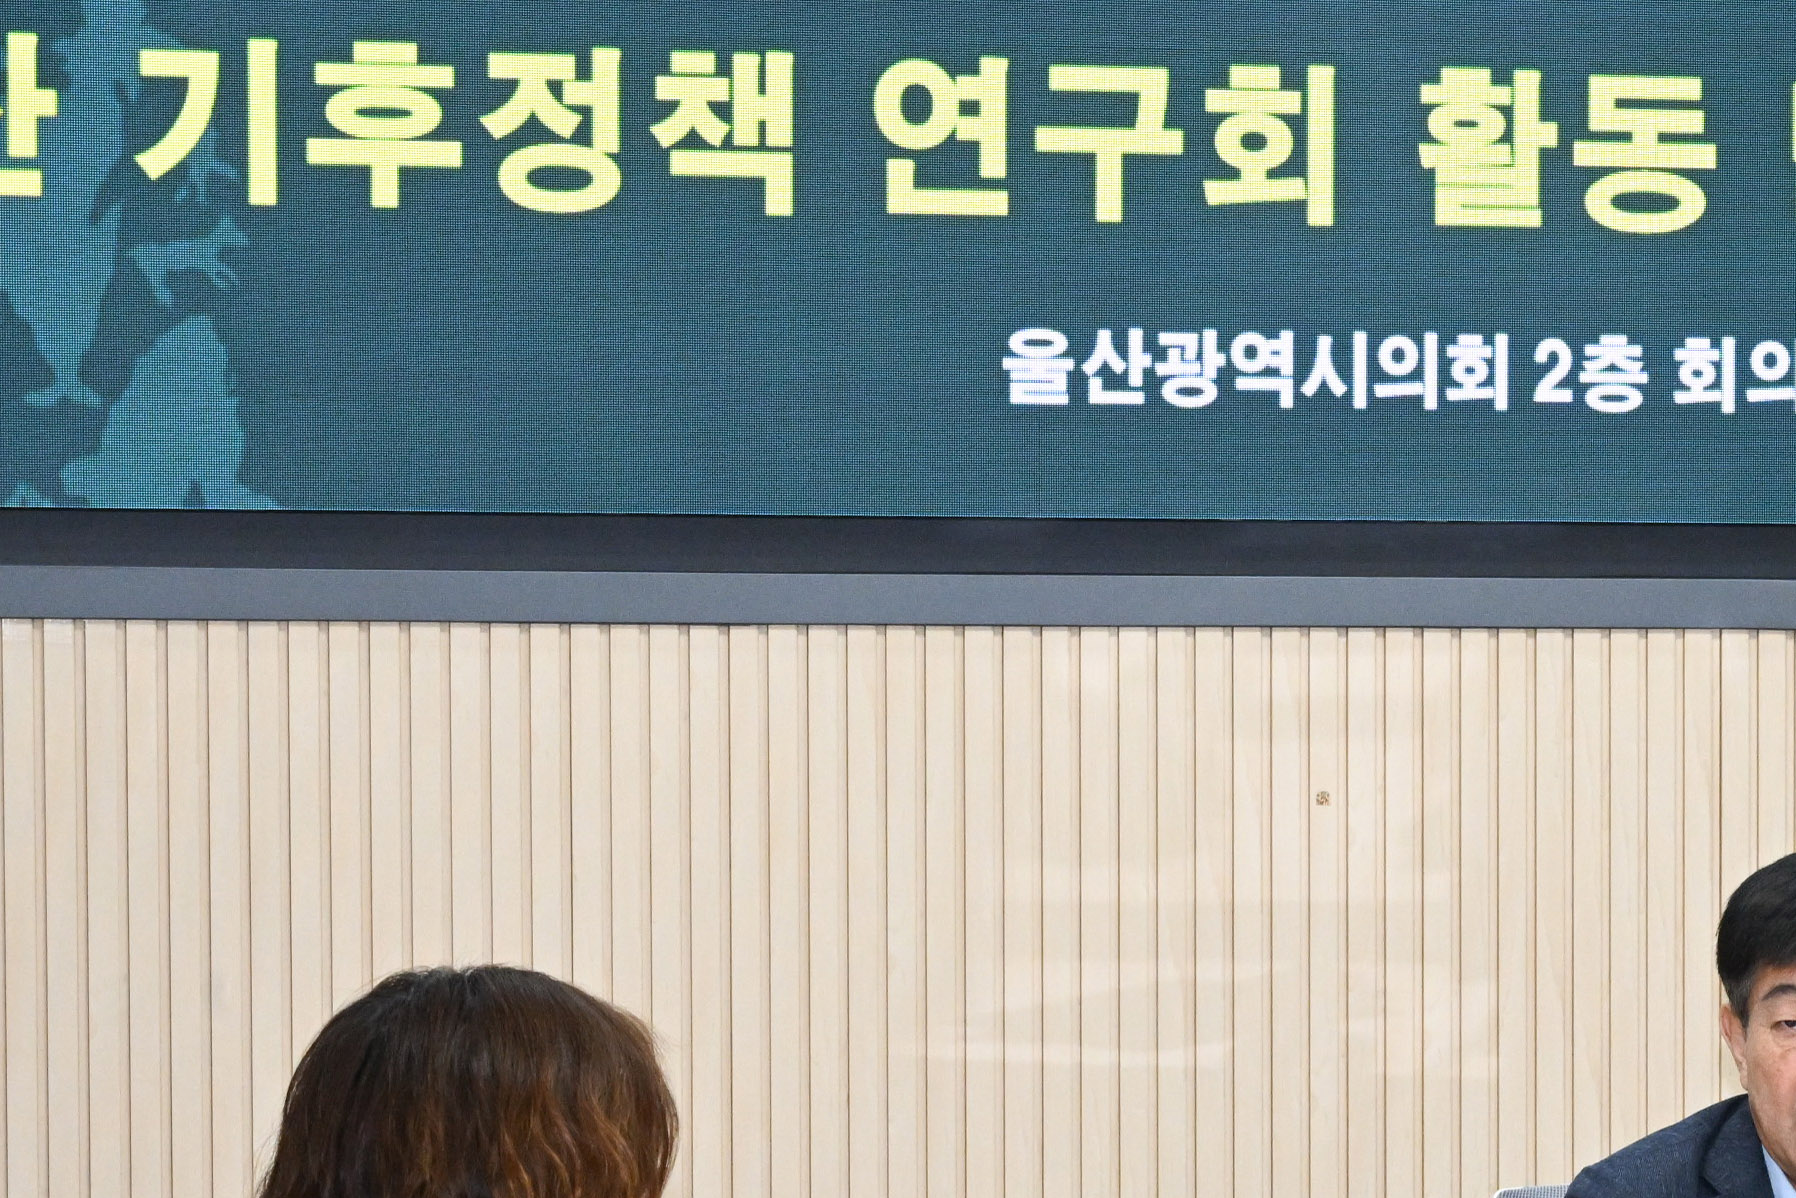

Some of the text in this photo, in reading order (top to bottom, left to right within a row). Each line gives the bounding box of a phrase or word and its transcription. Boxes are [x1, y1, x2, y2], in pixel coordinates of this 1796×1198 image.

[135, 38, 795, 217] 기후정책
[873, 56, 1336, 227] 연구회
[1418, 66, 1718, 234] 활동
[1001, 327, 1509, 411] 울산광역시의회
[1533, 334, 1649, 413] 2층
